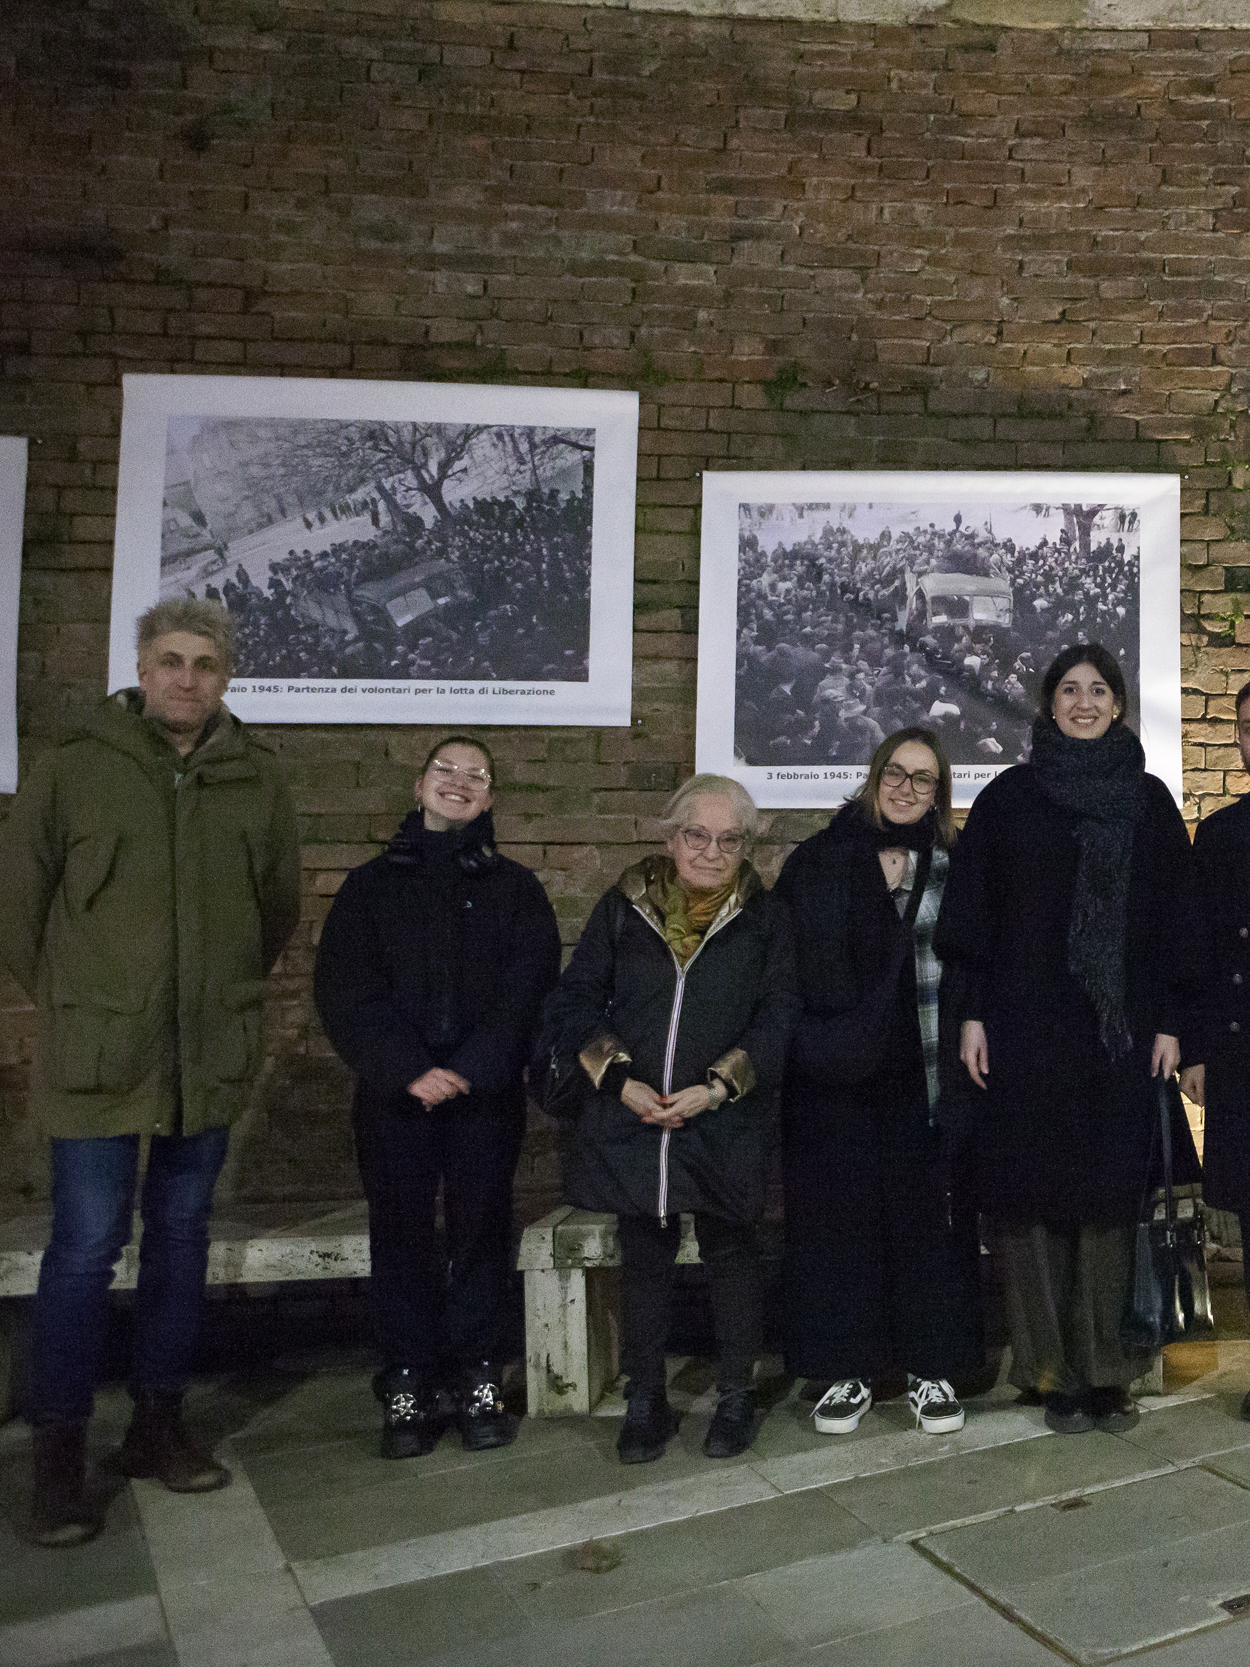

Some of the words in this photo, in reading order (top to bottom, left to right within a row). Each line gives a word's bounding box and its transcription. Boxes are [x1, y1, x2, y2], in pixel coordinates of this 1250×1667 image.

[251, 685, 284, 693] 1945:
[287, 685, 337, 694] Partenza
[340, 685, 358, 694] dei
[361, 685, 411, 694] volontari
[414, 687, 433, 696] per
[436, 686, 446, 695] la
[449, 686, 475, 695] lotta
[478, 686, 489, 695] di
[492, 687, 556, 696] Liberazione
[766, 772, 773, 780] 3
[776, 771, 820, 780] febbraio
[823, 771, 853, 780] 1945:
[974, 772, 991, 780] per
